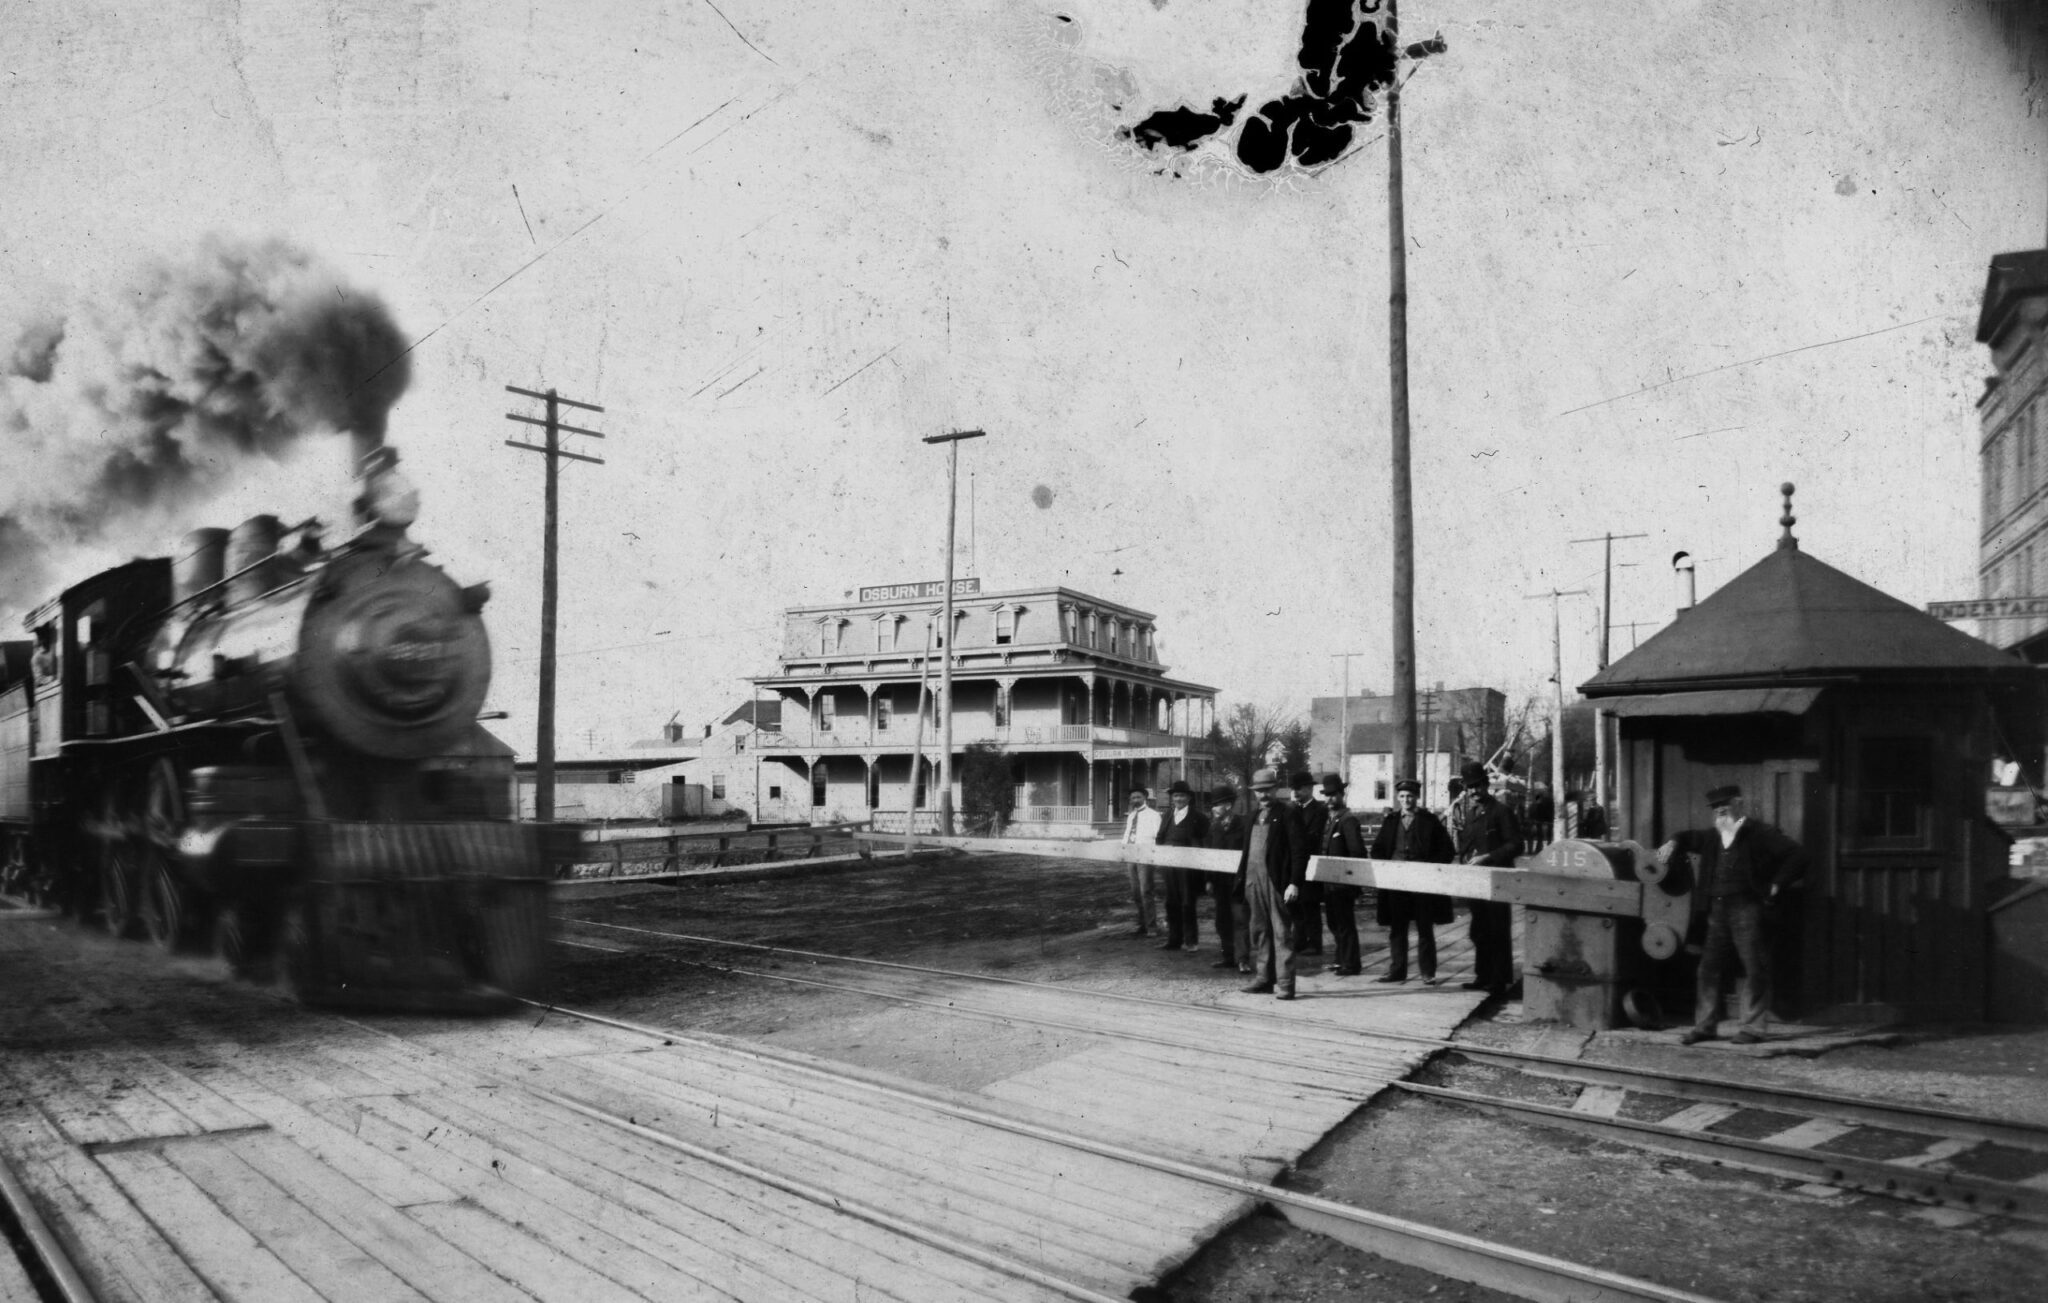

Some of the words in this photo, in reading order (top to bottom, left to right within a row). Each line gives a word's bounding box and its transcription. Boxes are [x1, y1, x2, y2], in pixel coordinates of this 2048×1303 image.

[862, 584, 920, 601] OSBURN
[925, 580, 979, 597] HOSE.
[1546, 851, 1586, 867] 415
